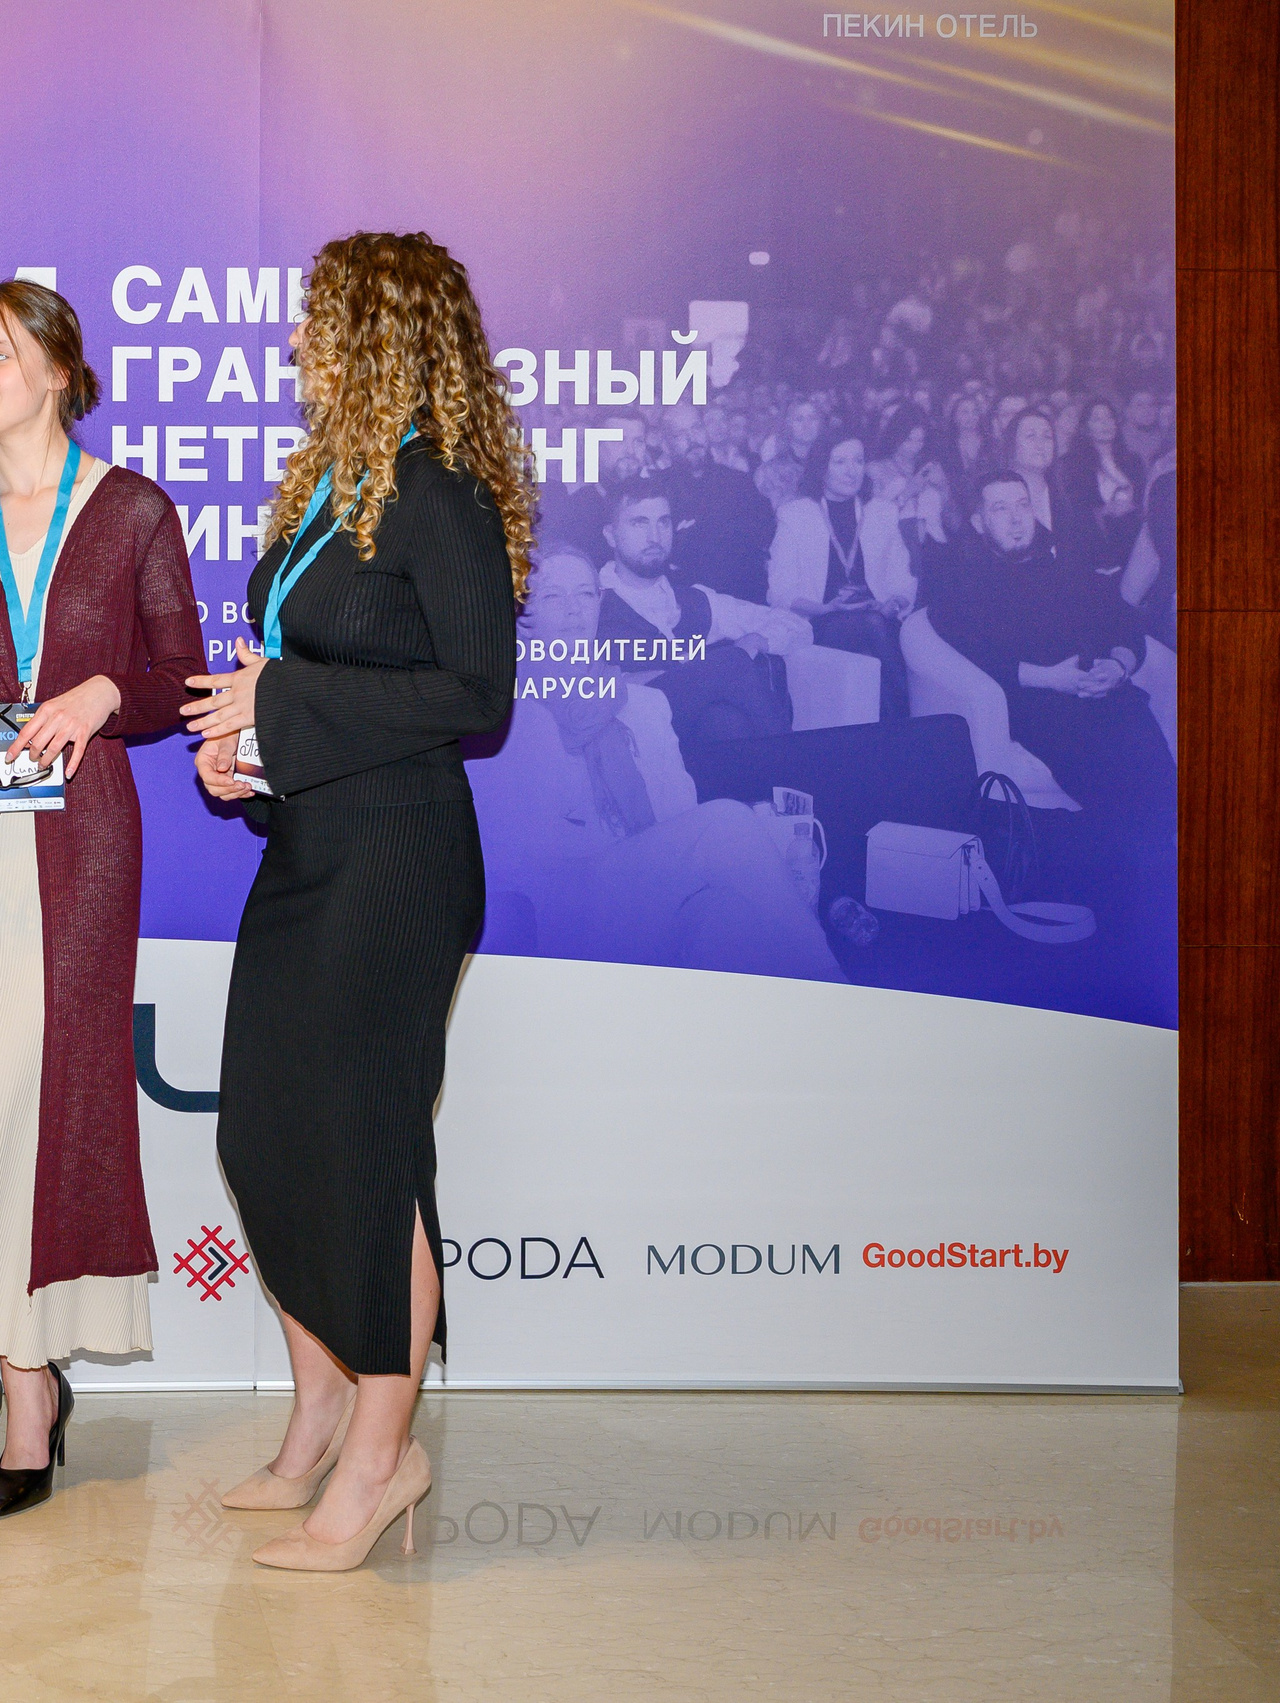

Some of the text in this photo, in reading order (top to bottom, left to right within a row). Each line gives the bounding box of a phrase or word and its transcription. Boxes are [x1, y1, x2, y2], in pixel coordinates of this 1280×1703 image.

[823, 13, 1039, 39] ПЕКИН ОТЕЛЬ
[111, 264, 310, 325] САМ
[111, 330, 708, 406] ГРАНЗНЫЙ
[515, 634, 707, 664] ОВОДИТЕЛЕЙ
[513, 676, 616, 699] АРУСИ
[646, 1243, 841, 1276] MODUM
[862, 1242, 1070, 1274] GoodStart.by
